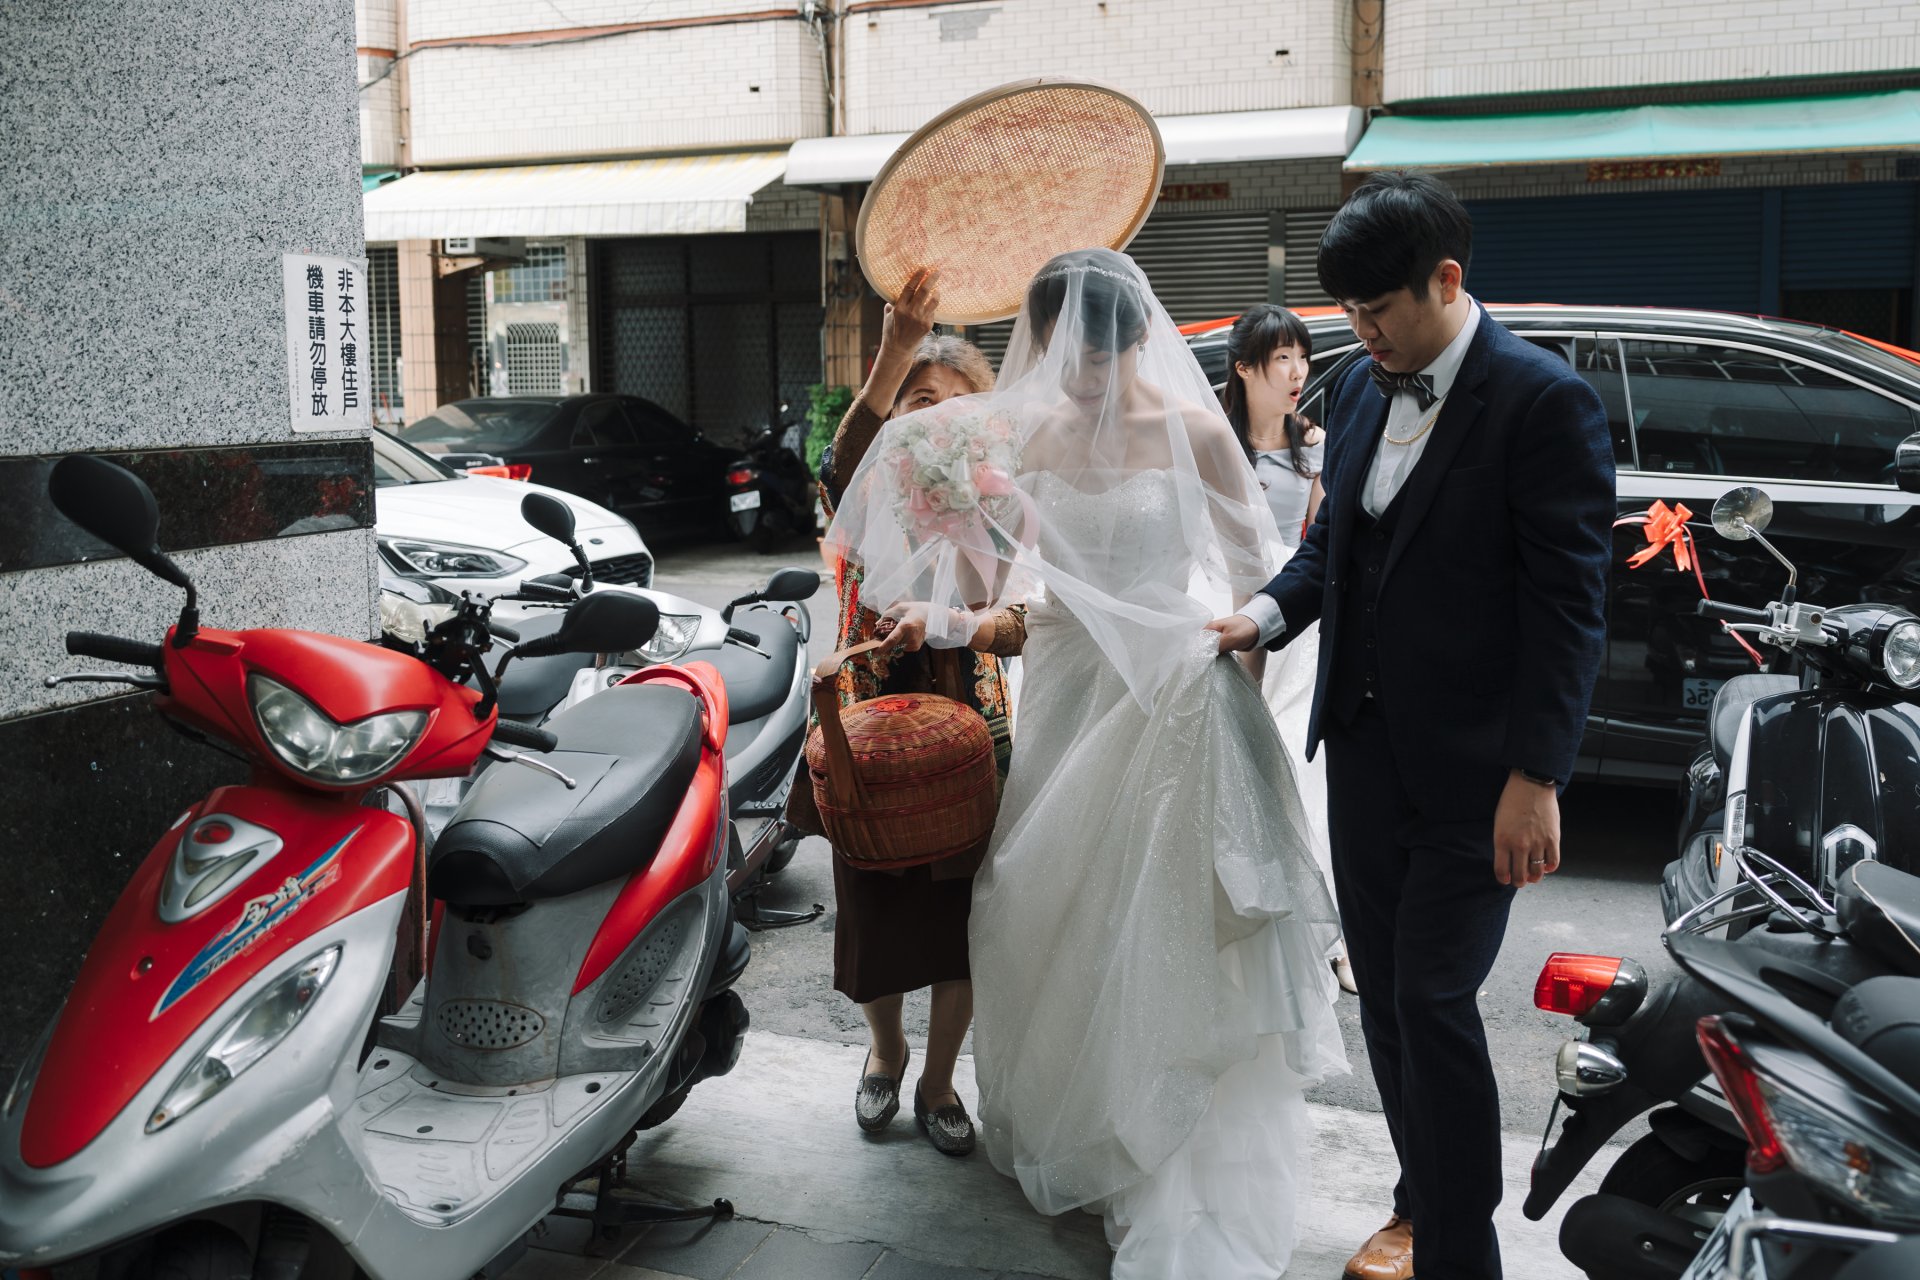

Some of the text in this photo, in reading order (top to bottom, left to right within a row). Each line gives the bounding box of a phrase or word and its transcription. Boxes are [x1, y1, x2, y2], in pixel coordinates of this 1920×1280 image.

[306, 264, 329, 417] 機車請勿停放
[337, 267, 359, 416] 非本大樓住戶
